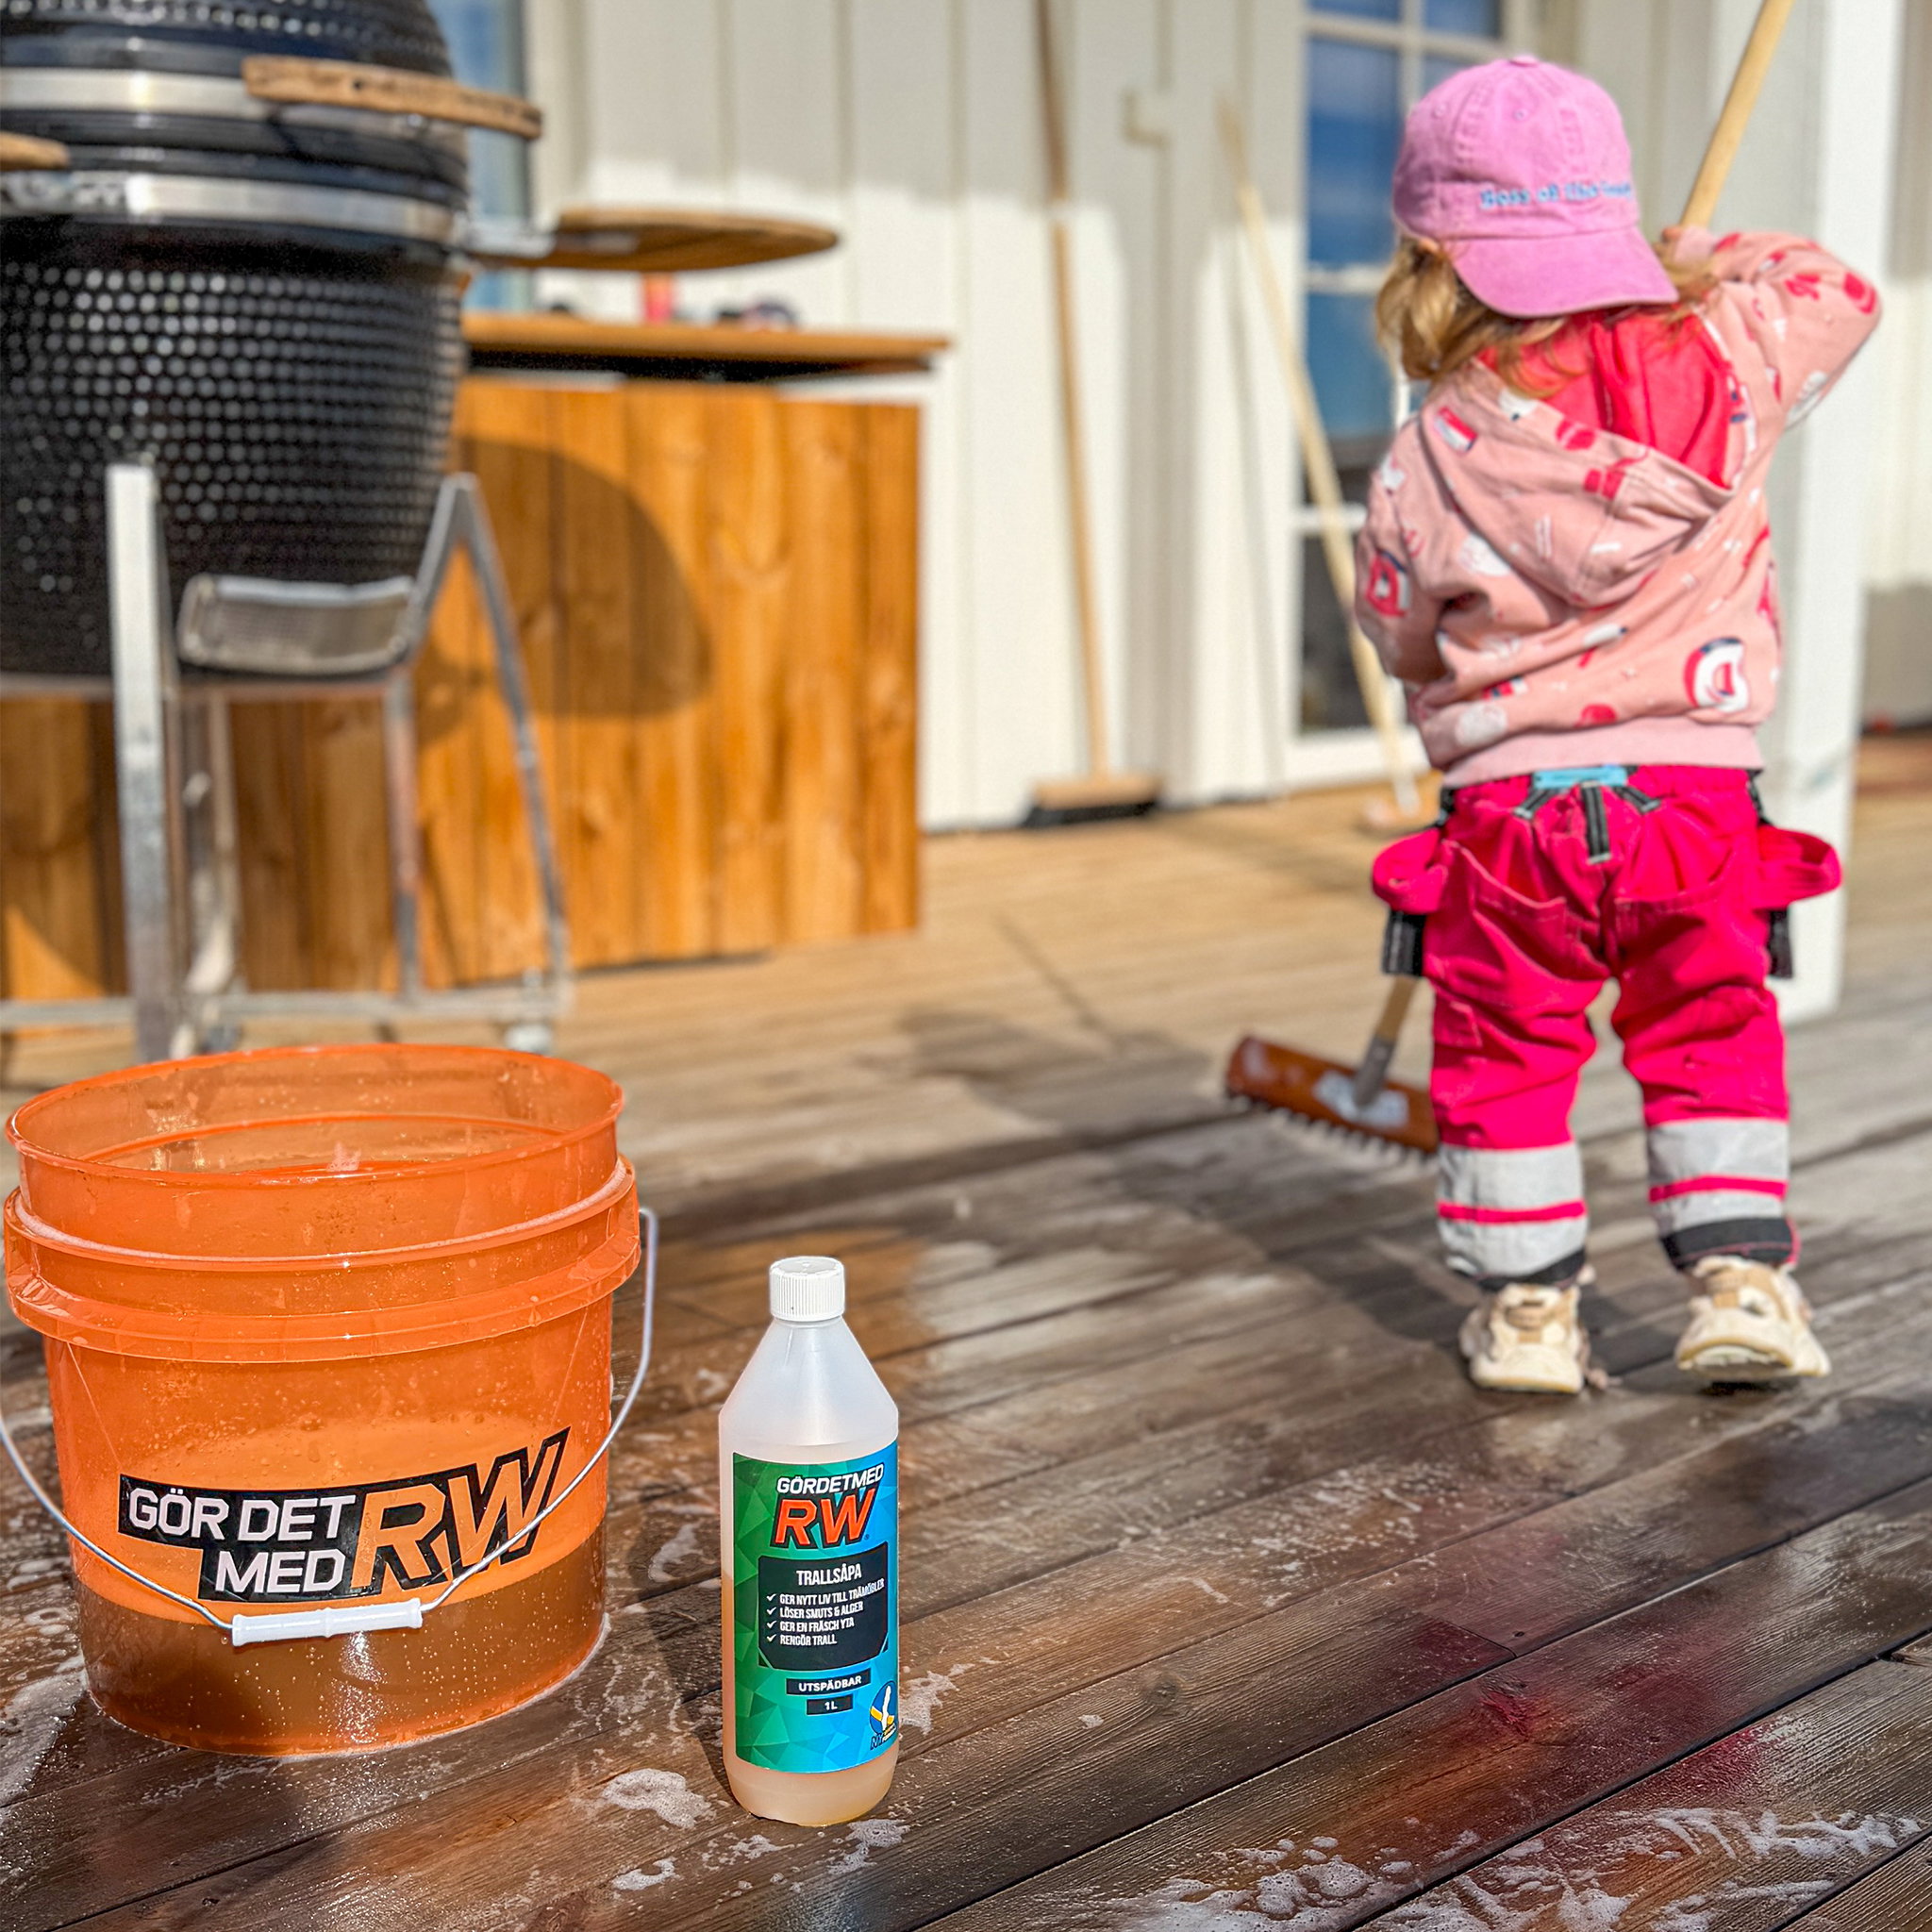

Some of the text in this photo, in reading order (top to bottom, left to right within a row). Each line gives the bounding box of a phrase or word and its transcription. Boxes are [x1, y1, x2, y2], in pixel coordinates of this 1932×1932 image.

[776, 1463, 885, 1495] GÖRDETMED
[128, 1487, 357, 1541] GÖR DET
[349, 1440, 561, 1592] RW
[774, 1488, 876, 1545] RW
[215, 1548, 346, 1594] MED
[796, 1563, 862, 1586] TRALLSÅPA
[779, 1593, 795, 1605] GER
[796, 1594, 817, 1606] NYTT
[818, 1593, 832, 1605] LIV
[832, 1591, 848, 1604] TILL
[779, 1607, 805, 1619] LÖSER
[806, 1607, 833, 1619] SMUTS
[841, 1601, 864, 1615] ALGER
[779, 1617, 855, 1633] GER EN FRÄSCH YTA
[779, 1634, 838, 1646] RENGÖR TRALL
[798, 1675, 862, 1691] UTSPÄDBAR
